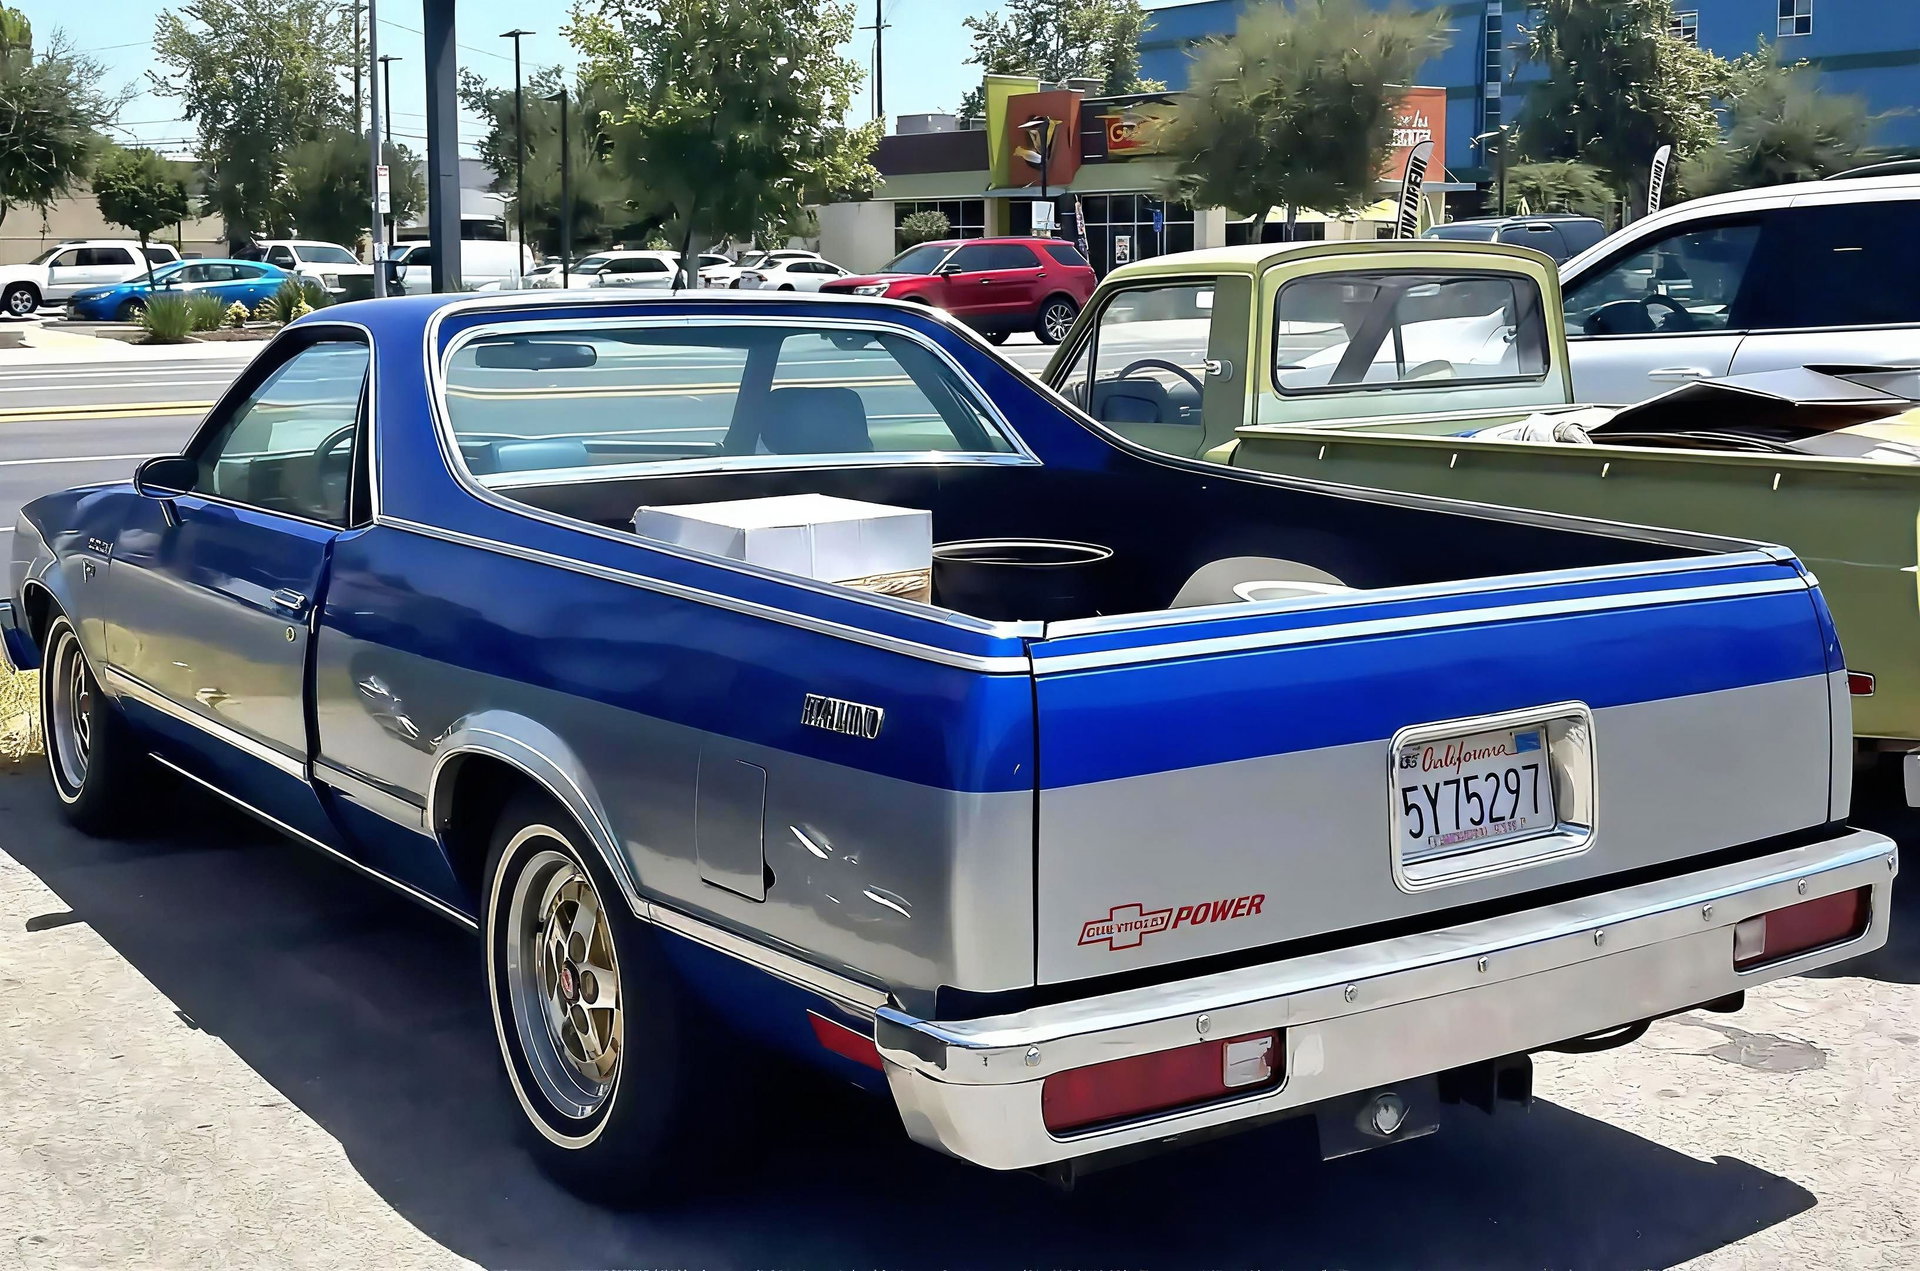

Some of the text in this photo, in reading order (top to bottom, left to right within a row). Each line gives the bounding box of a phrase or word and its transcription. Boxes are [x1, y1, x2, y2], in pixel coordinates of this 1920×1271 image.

[1422, 740, 1518, 775] California
[1402, 763, 1539, 839] 5Y75297
[1171, 893, 1266, 929] POWER
